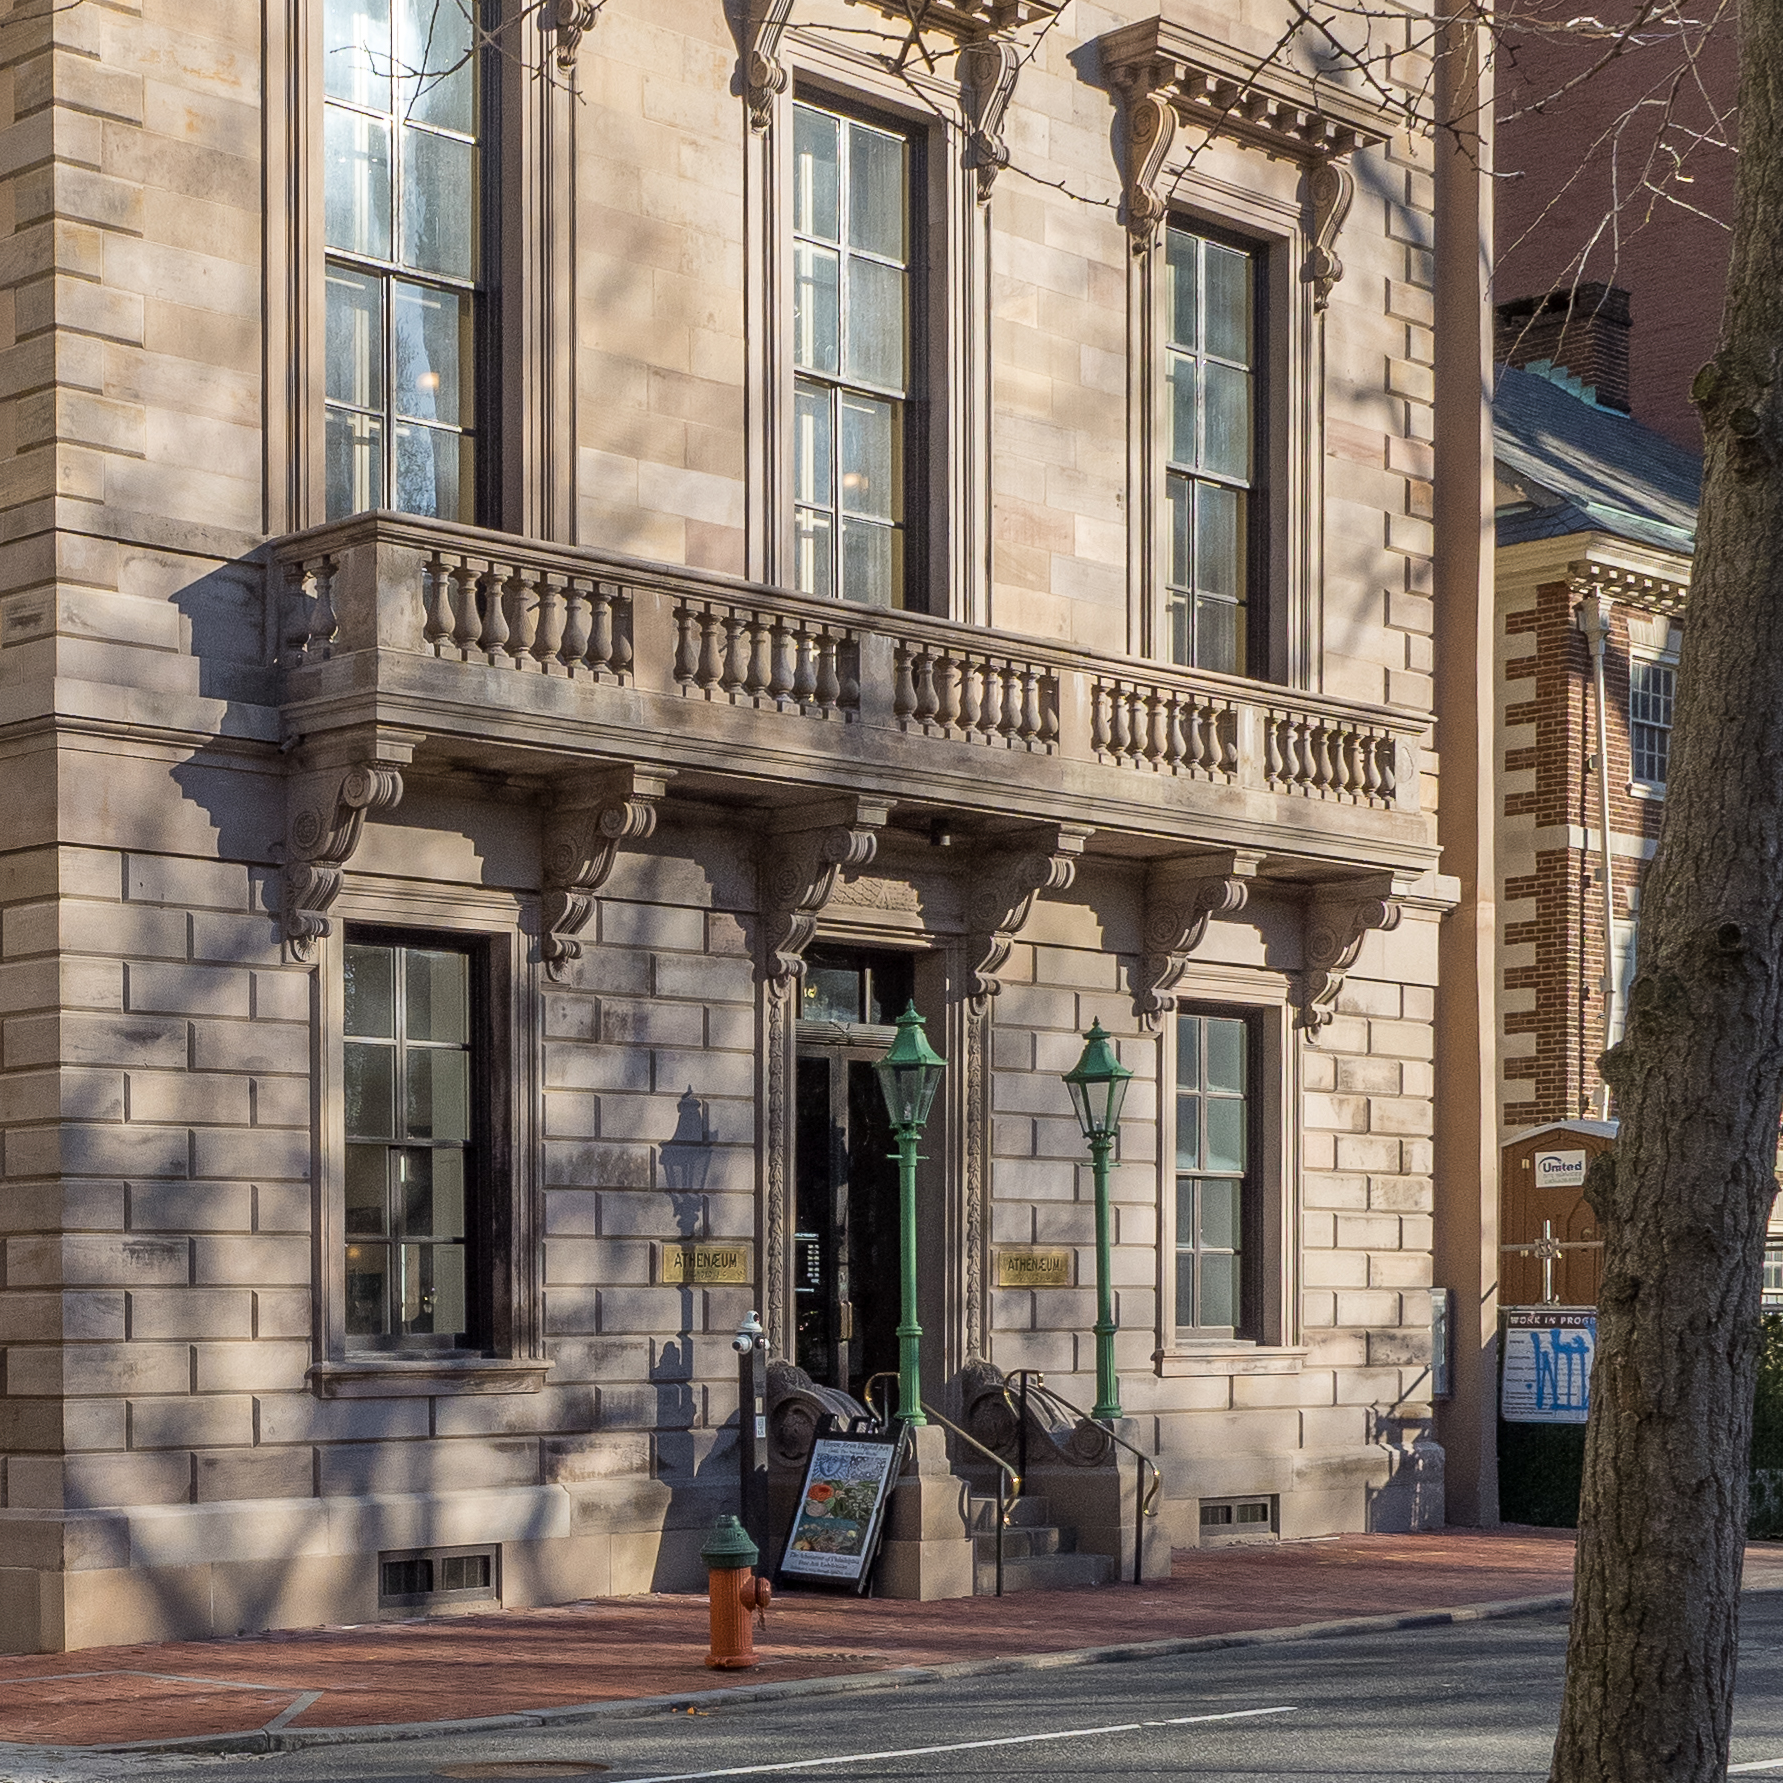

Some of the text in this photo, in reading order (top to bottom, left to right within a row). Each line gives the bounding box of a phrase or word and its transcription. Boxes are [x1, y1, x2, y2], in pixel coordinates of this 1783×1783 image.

[674, 1253, 737, 1268] ATHENÆUM
[1510, 1316, 1540, 1325] WORK
[1544, 1316, 1556, 1325] IN
